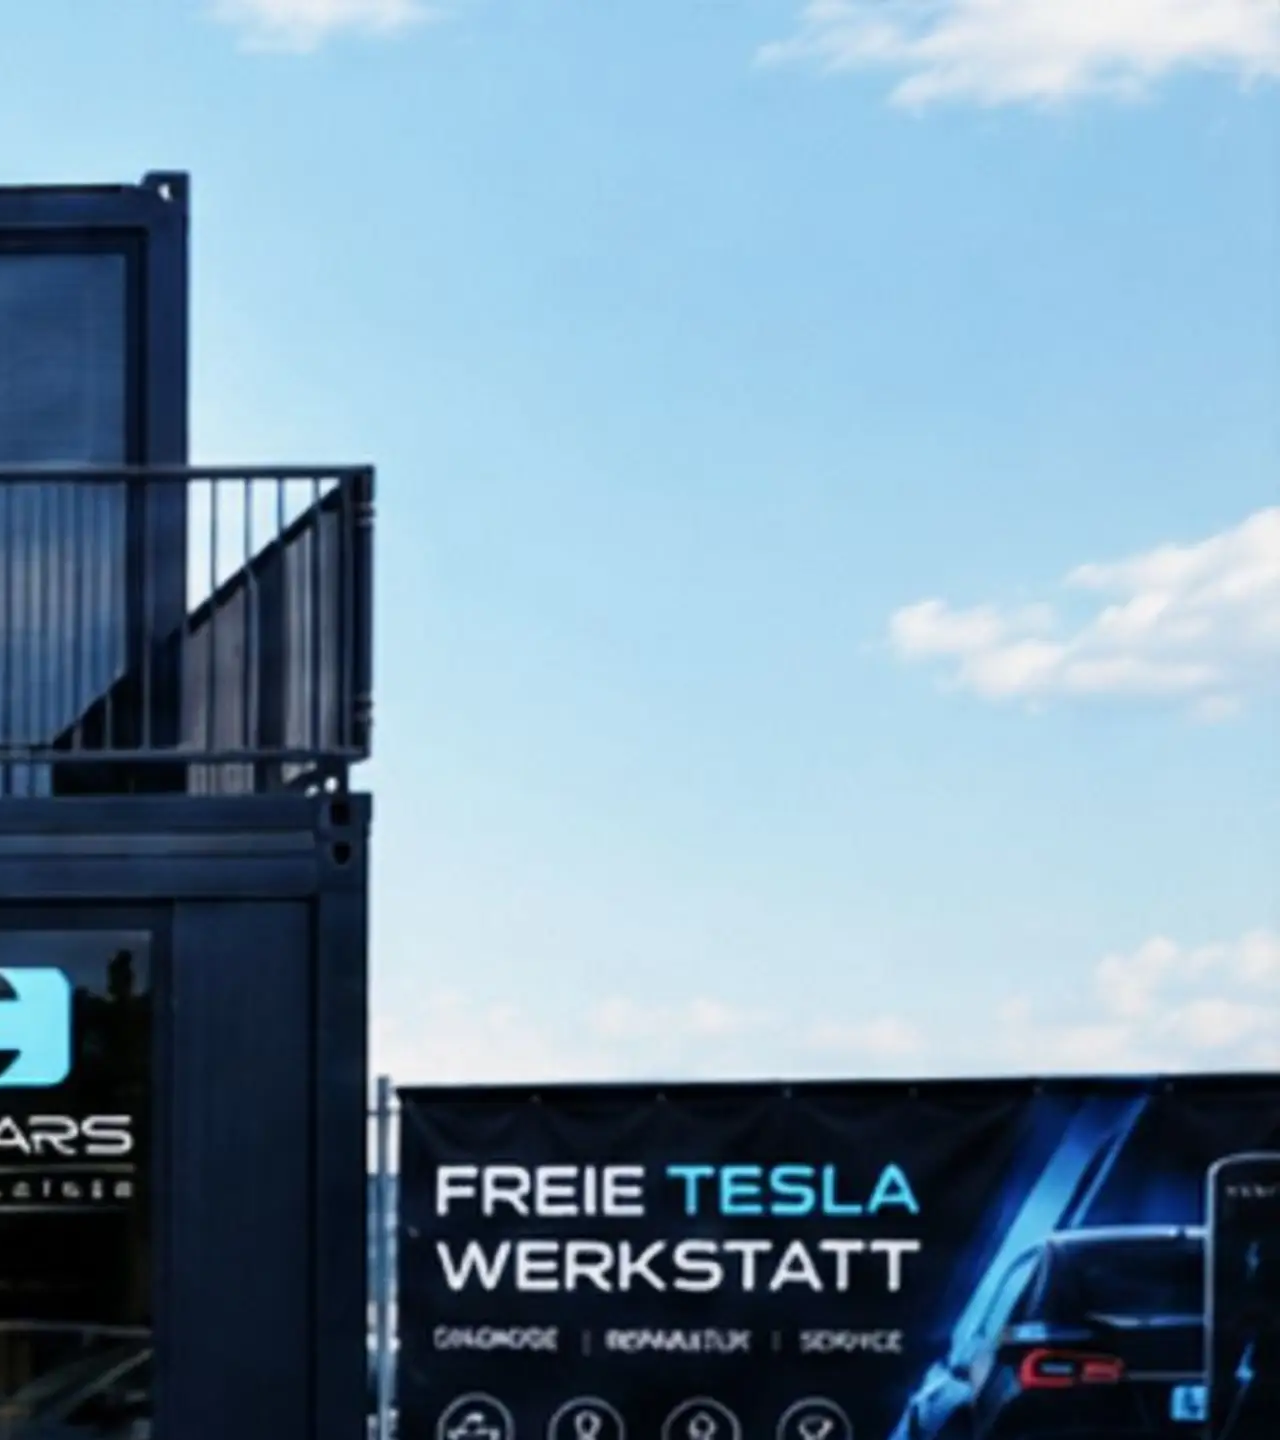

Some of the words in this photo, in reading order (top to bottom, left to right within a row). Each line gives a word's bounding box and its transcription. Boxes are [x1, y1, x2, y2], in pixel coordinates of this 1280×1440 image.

[436, 1165, 645, 1217] FREIE
[667, 1164, 920, 1216] TESLA
[436, 1238, 921, 1292] WERKSTATT
